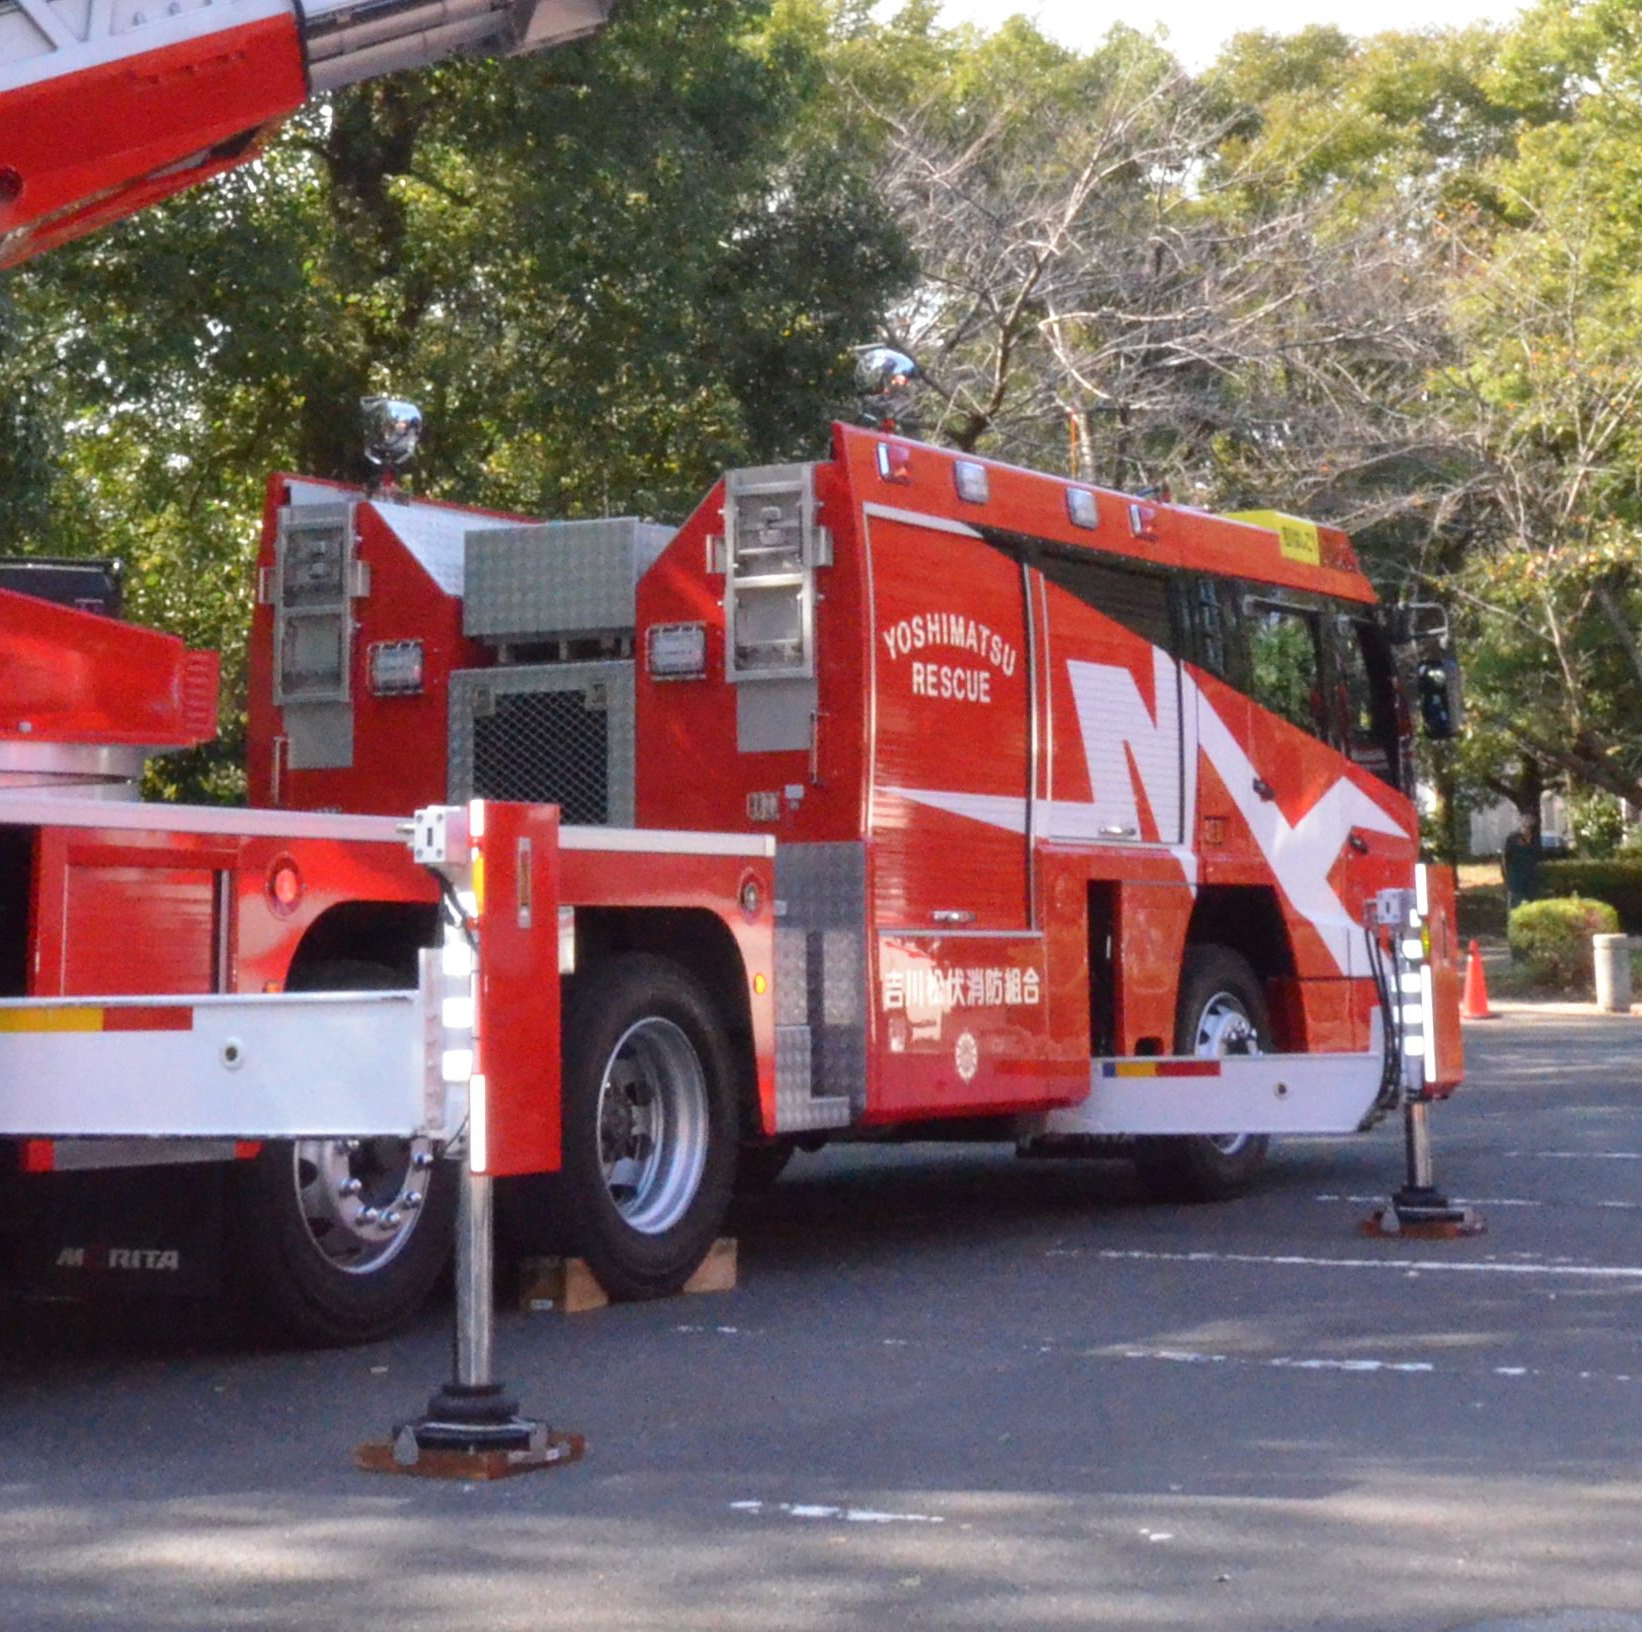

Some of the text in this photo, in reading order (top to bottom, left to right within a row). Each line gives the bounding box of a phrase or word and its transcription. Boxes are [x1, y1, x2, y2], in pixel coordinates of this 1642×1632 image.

[883, 611, 1017, 677] YOSHIMATSU
[912, 661, 991, 704] RESCUE
[884, 966, 1041, 1008] 吉川松伏消防組合
